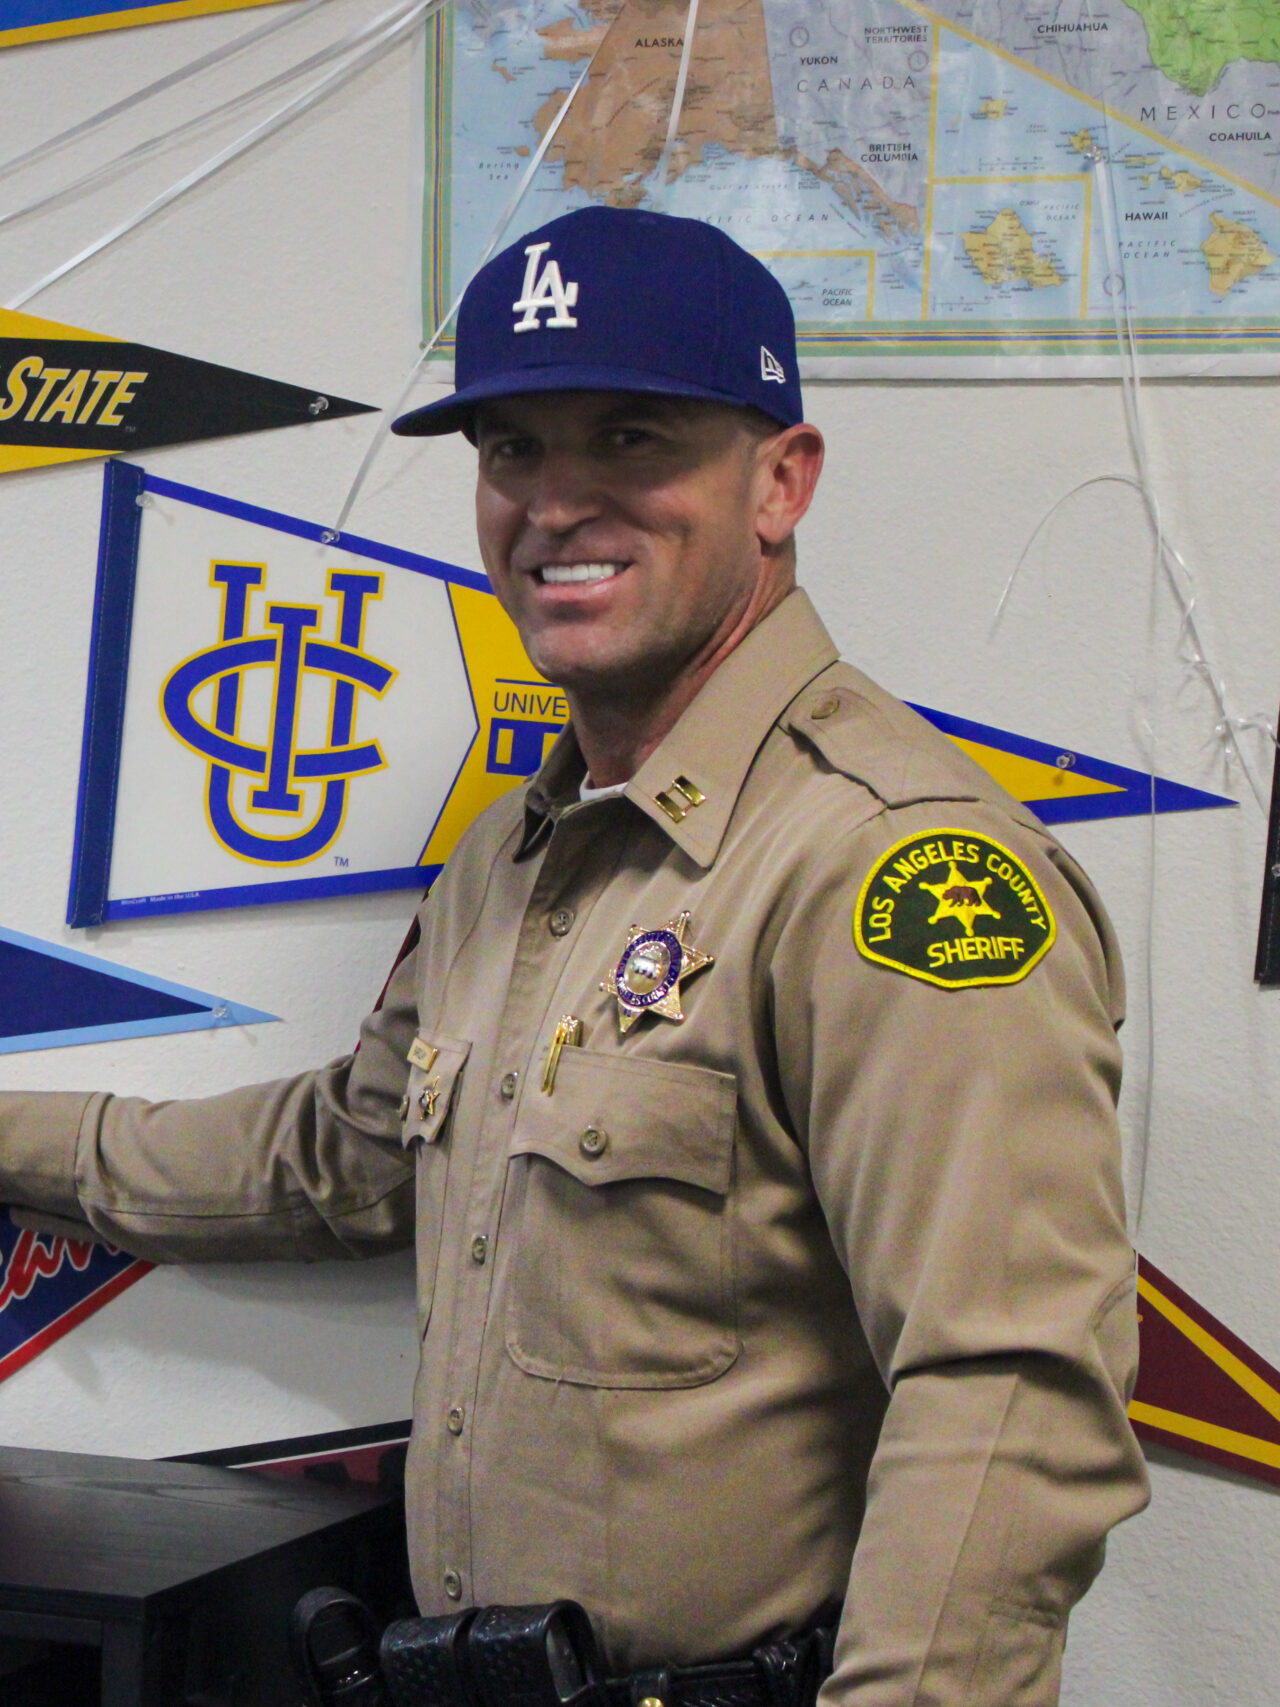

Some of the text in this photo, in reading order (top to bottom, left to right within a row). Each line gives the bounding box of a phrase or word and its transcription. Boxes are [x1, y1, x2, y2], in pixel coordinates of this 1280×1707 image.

[864, 25, 929, 35] NORTHWEST
[1037, 22, 1109, 34] CHIHUAHUA
[634, 37, 684, 48] ALASKA
[865, 34, 928, 44] TERRITORIES
[800, 55, 839, 66] YUKON
[796, 75, 916, 94] CANADA
[1140, 103, 1266, 122] MEXICO
[1208, 132, 1272, 142] COAHUILA
[869, 143, 912, 152] BRITISH
[860, 153, 919, 163] COLUMBIA
[1125, 211, 1169, 222] HAWAII
[513, 242, 579, 333] LA
[822, 287, 854, 297] PACIFIC
[822, 297, 853, 307] OCEAN
[494, 690, 568, 718] UNIVE
[868, 840, 1048, 943] LOS ANGELES COUNTY
[926, 936, 1025, 968] SHERIFF
